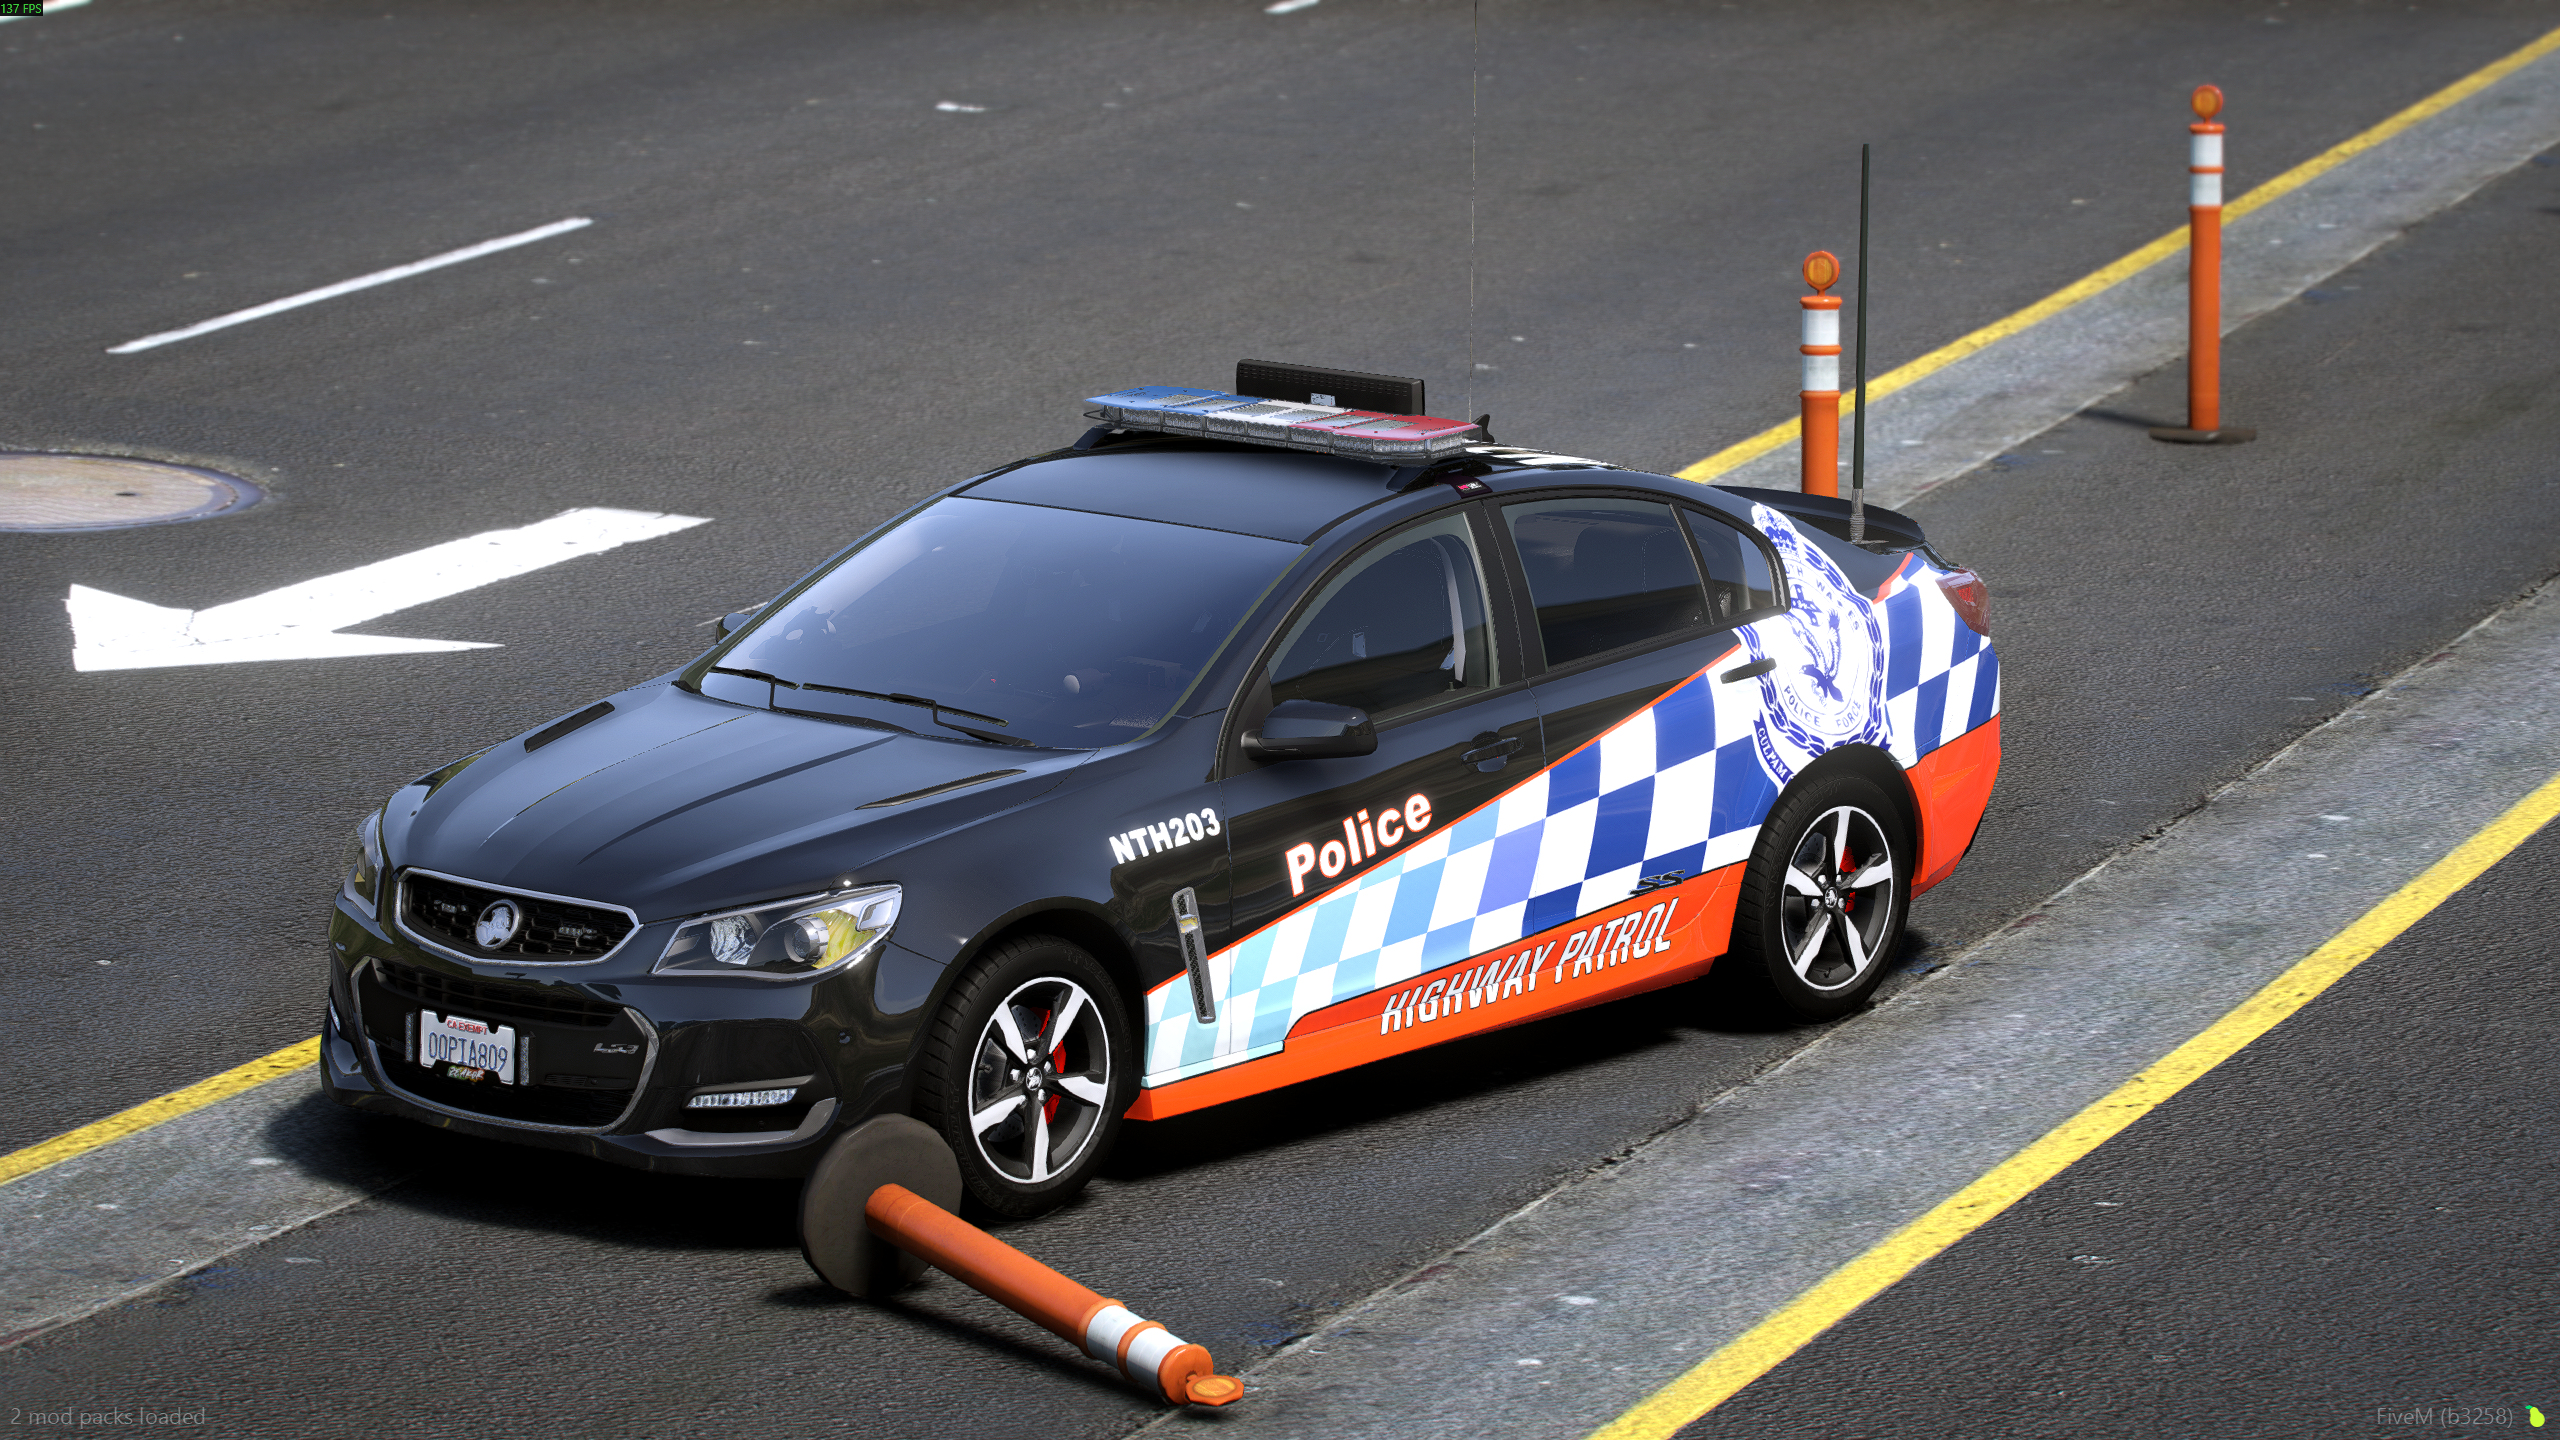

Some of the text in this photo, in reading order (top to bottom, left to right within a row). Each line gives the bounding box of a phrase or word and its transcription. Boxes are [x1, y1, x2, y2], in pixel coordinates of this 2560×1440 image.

[1783, 684, 1822, 728] POLICE
[1835, 699, 1862, 728] FORCE
[1757, 727, 1789, 779] CULPAM
[1108, 807, 1221, 865] NTH203
[1284, 792, 1433, 898] Police
[1627, 869, 1685, 895] SS
[1380, 897, 1680, 1036] HIGHWAY PATROL
[446, 1019, 488, 1035] CA EXEMPT
